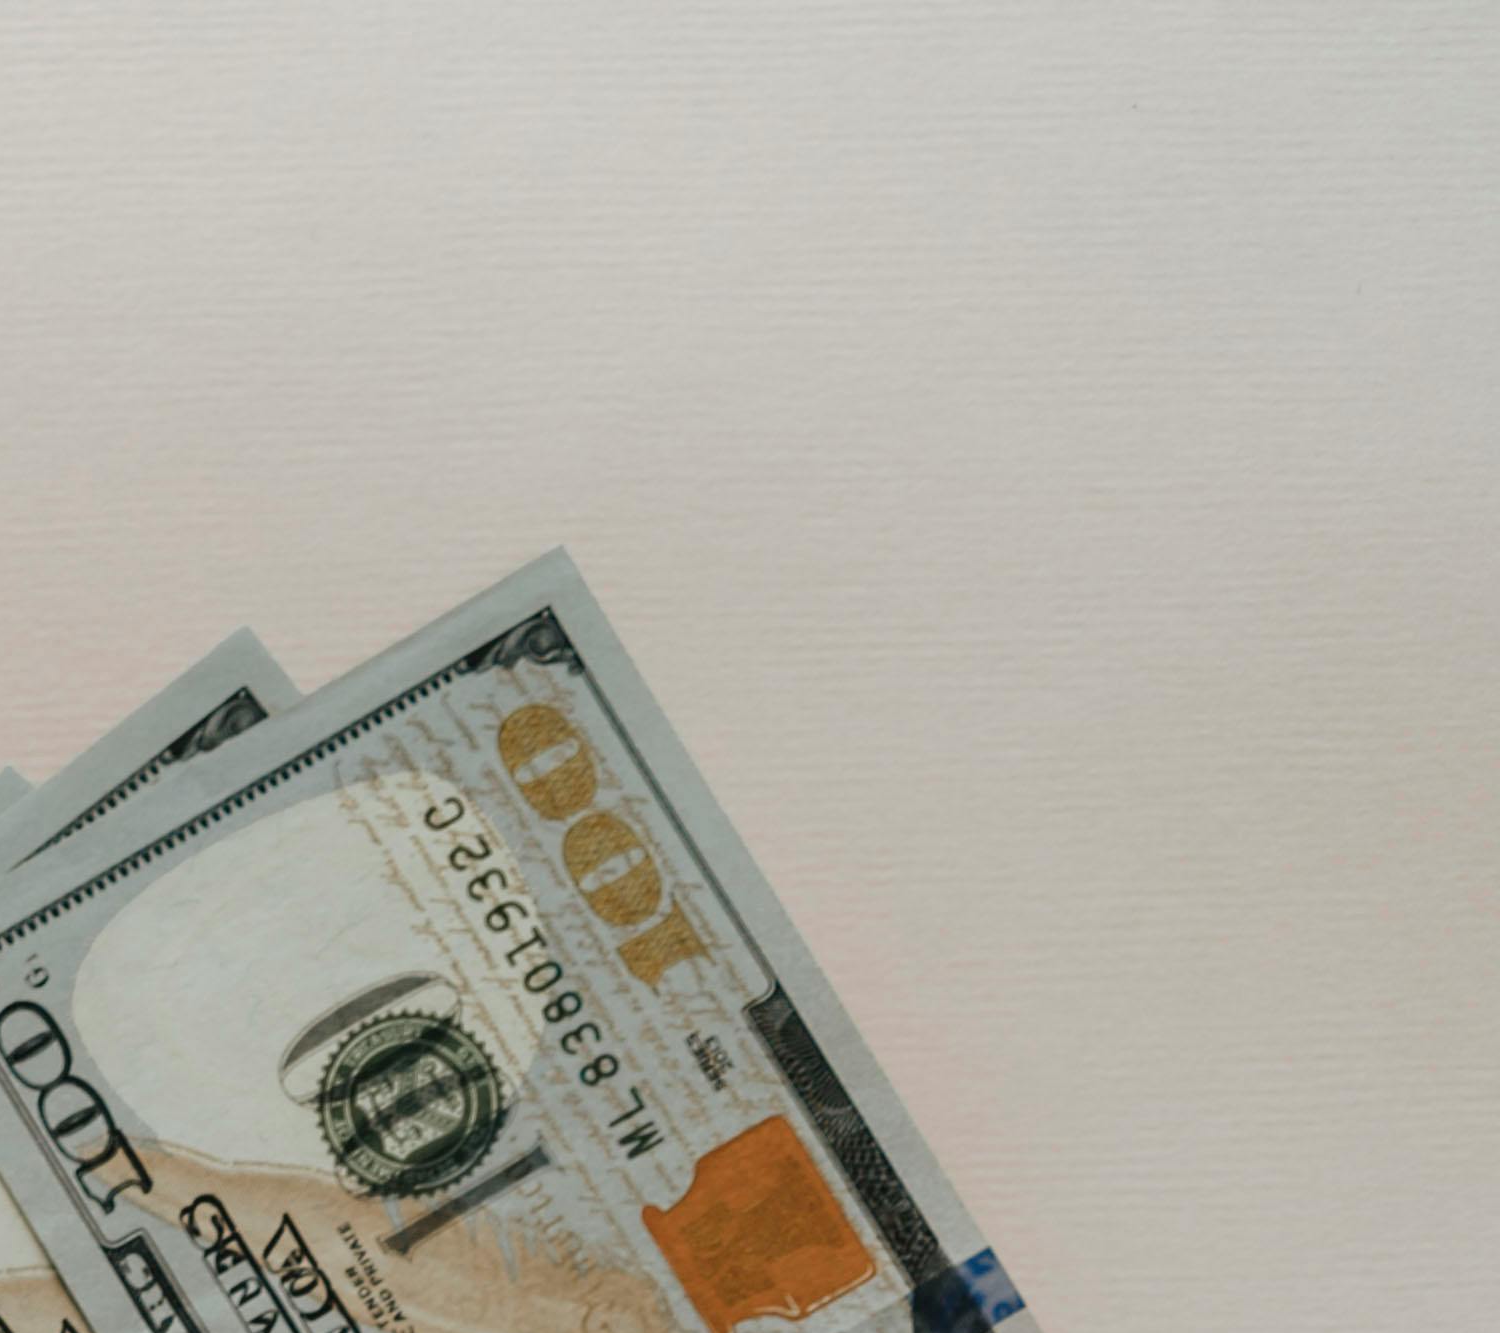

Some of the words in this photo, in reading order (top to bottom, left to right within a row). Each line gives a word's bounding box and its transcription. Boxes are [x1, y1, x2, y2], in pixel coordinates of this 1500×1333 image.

[421, 794, 465, 832] C
[497, 703, 717, 995] 100
[449, 833, 621, 1083] 83801932
[605, 1083, 665, 1161] ML
